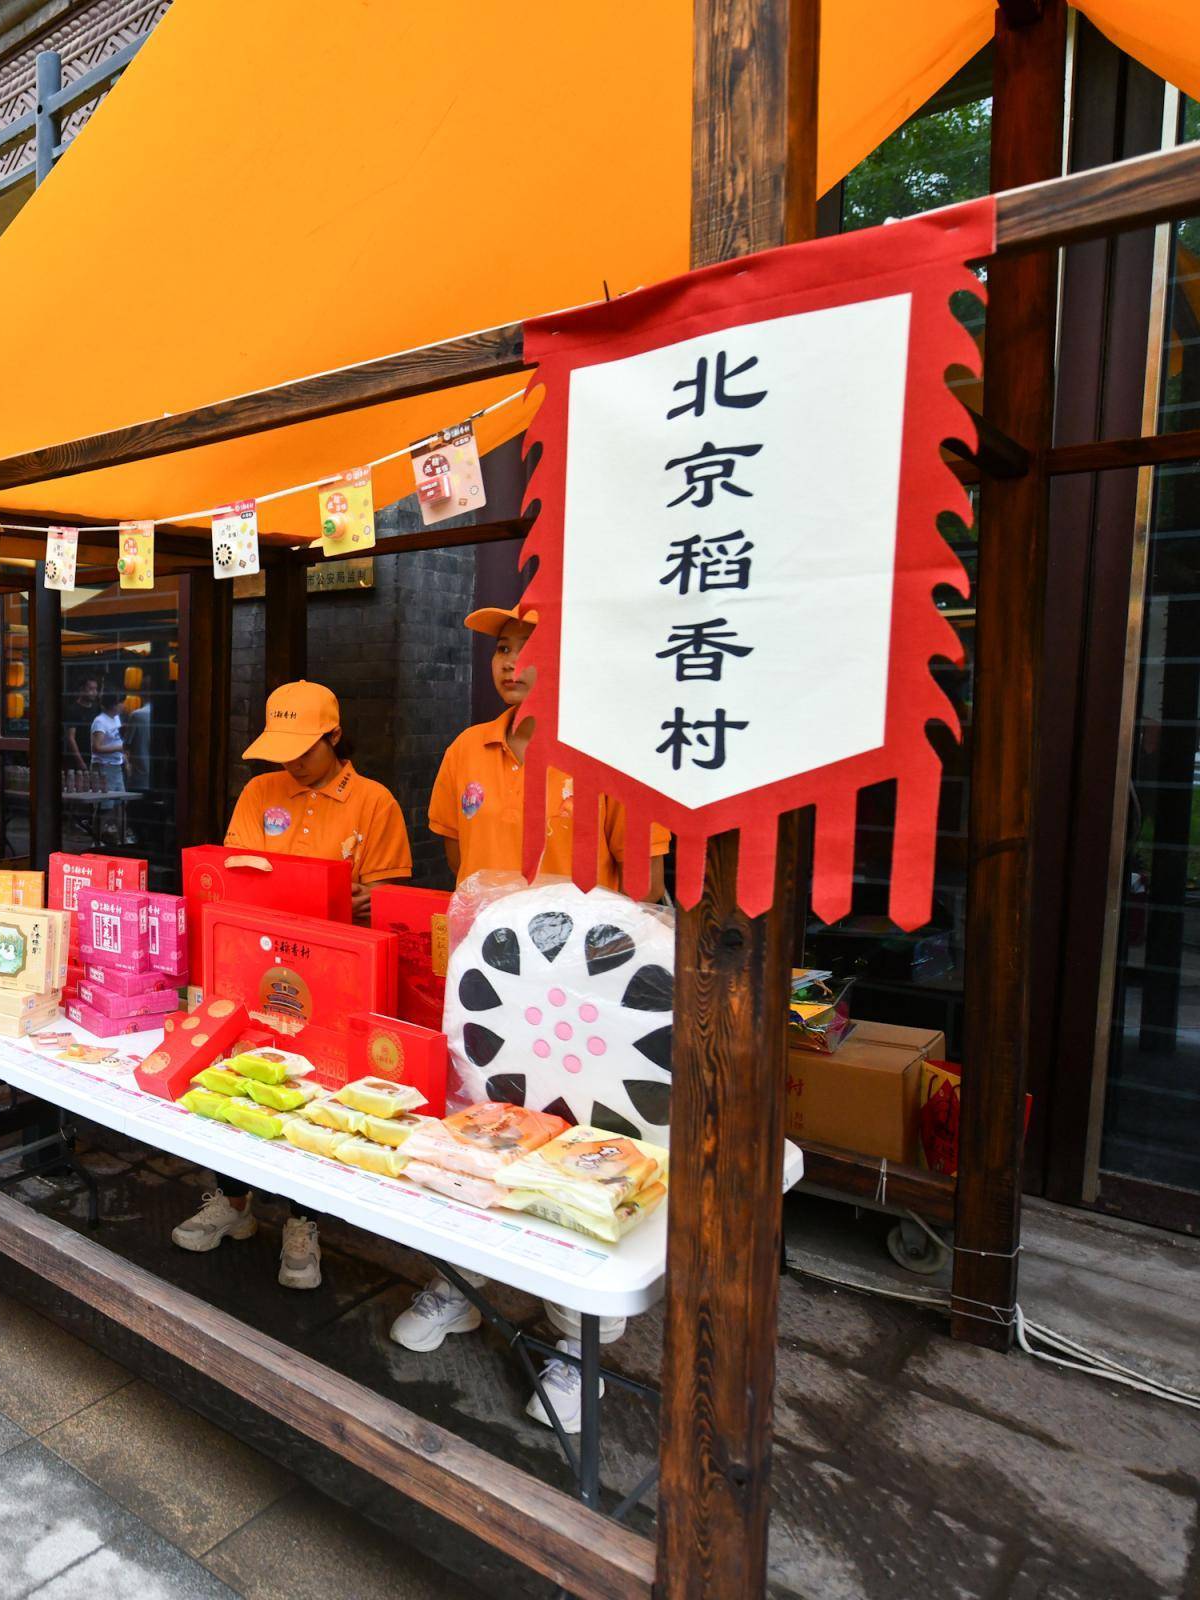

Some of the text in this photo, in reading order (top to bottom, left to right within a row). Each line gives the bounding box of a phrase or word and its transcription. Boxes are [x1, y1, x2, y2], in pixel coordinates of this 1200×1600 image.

[656, 350, 768, 770] 北京稻香村
